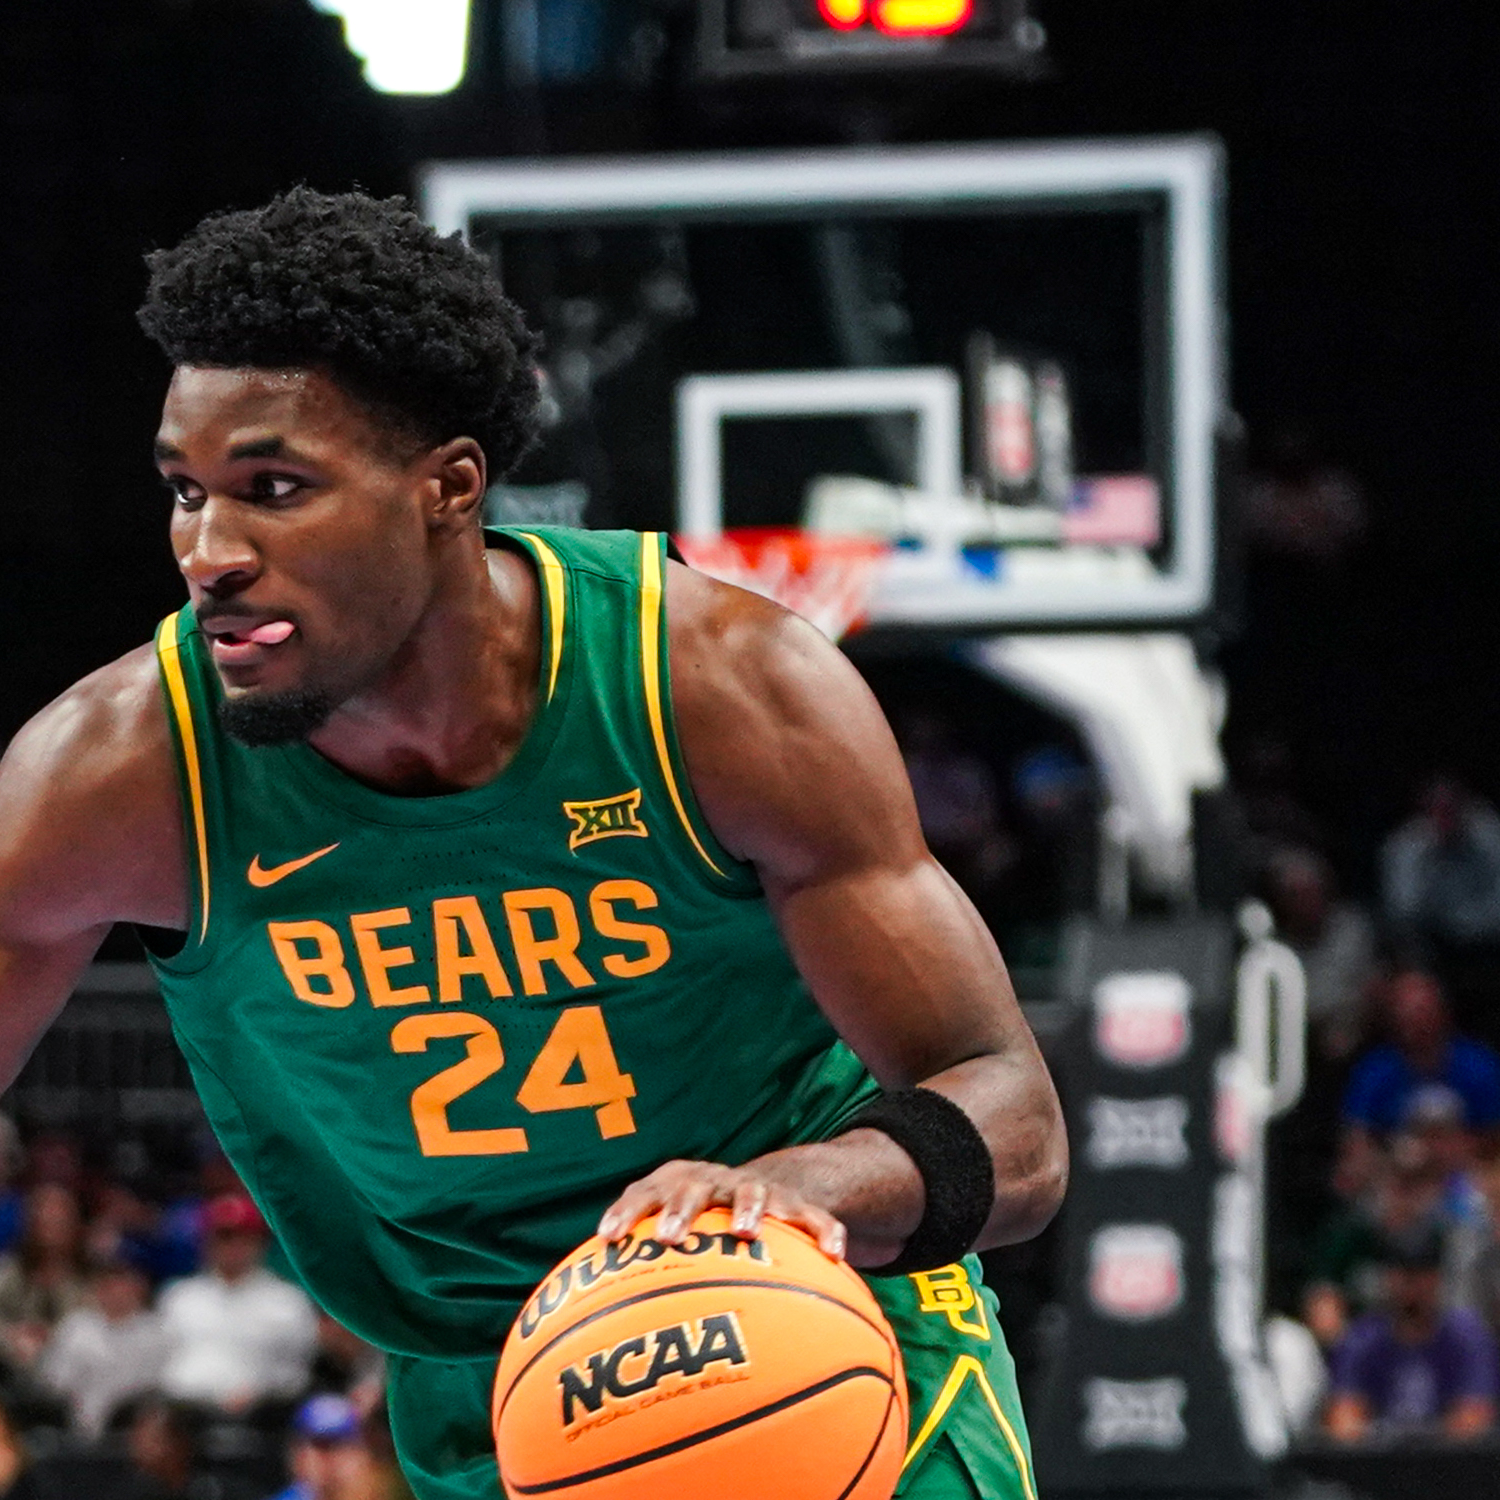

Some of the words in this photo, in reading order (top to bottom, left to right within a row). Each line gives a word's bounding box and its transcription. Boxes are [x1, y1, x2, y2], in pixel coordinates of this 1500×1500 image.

[267, 879, 671, 1009] BEARS
[390, 1006, 638, 1157] 24
[519, 1232, 770, 1339] Wilson
[558, 1313, 749, 1427] NCAA
[639, 1384, 694, 1410] GAME
[699, 1371, 751, 1391] BALL
